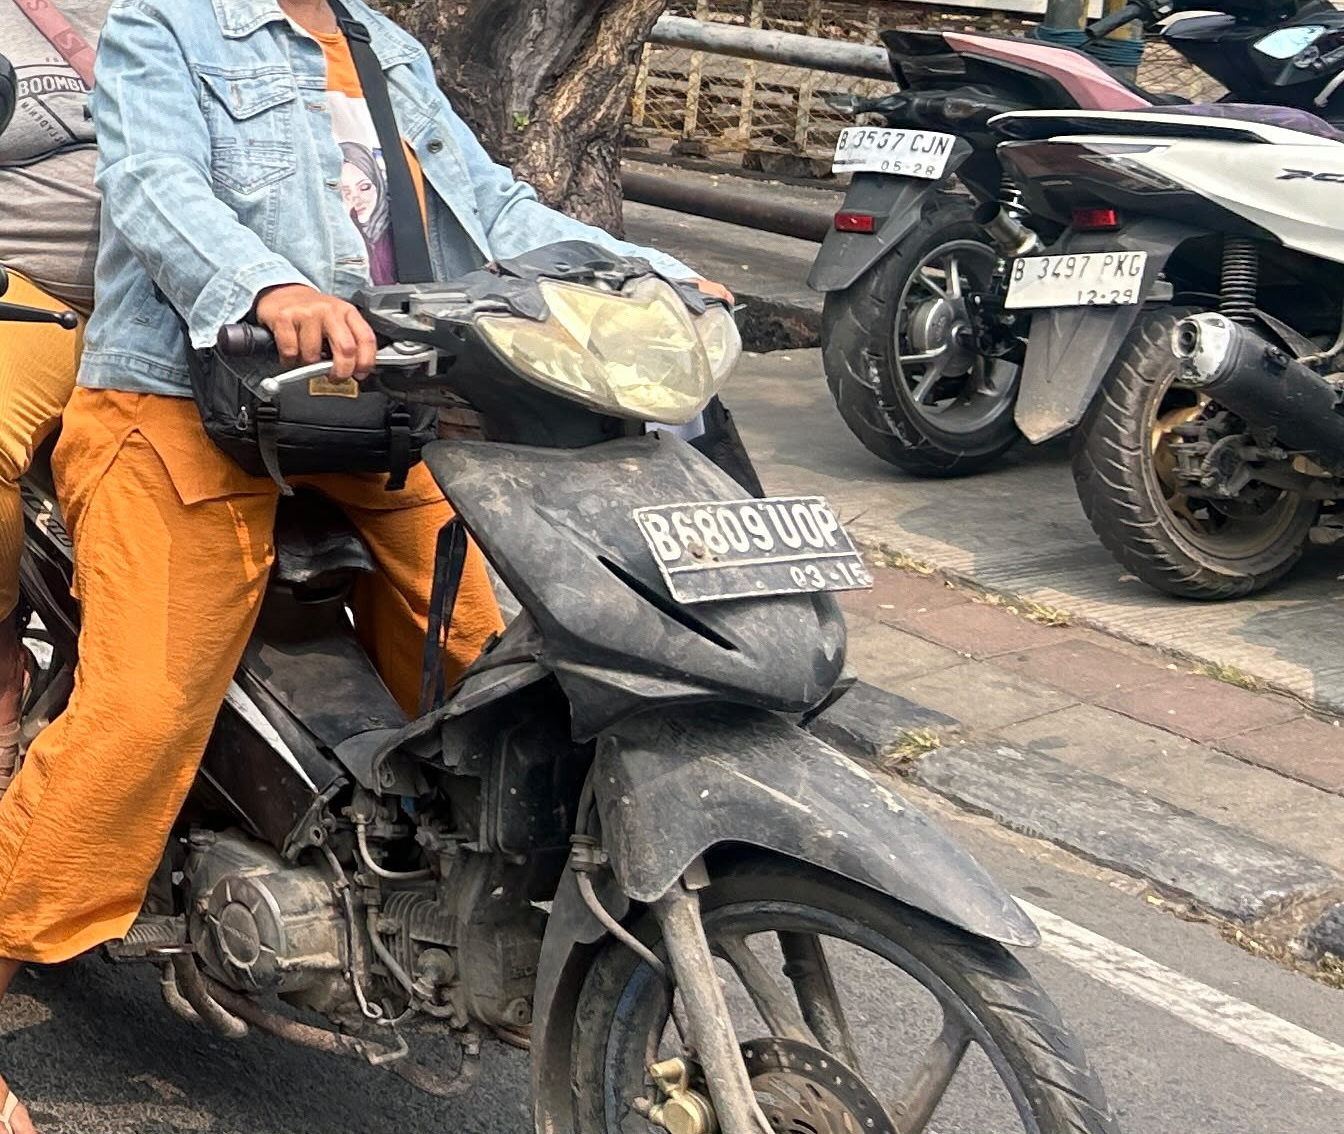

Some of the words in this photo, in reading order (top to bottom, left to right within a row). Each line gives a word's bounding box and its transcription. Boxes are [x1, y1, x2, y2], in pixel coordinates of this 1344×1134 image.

[839, 130, 849, 150] B
[910, 134, 950, 156] CJN
[1014, 258, 1026, 281] B
[1038, 255, 1091, 279] 3497
[1100, 254, 1142, 277] PKG
